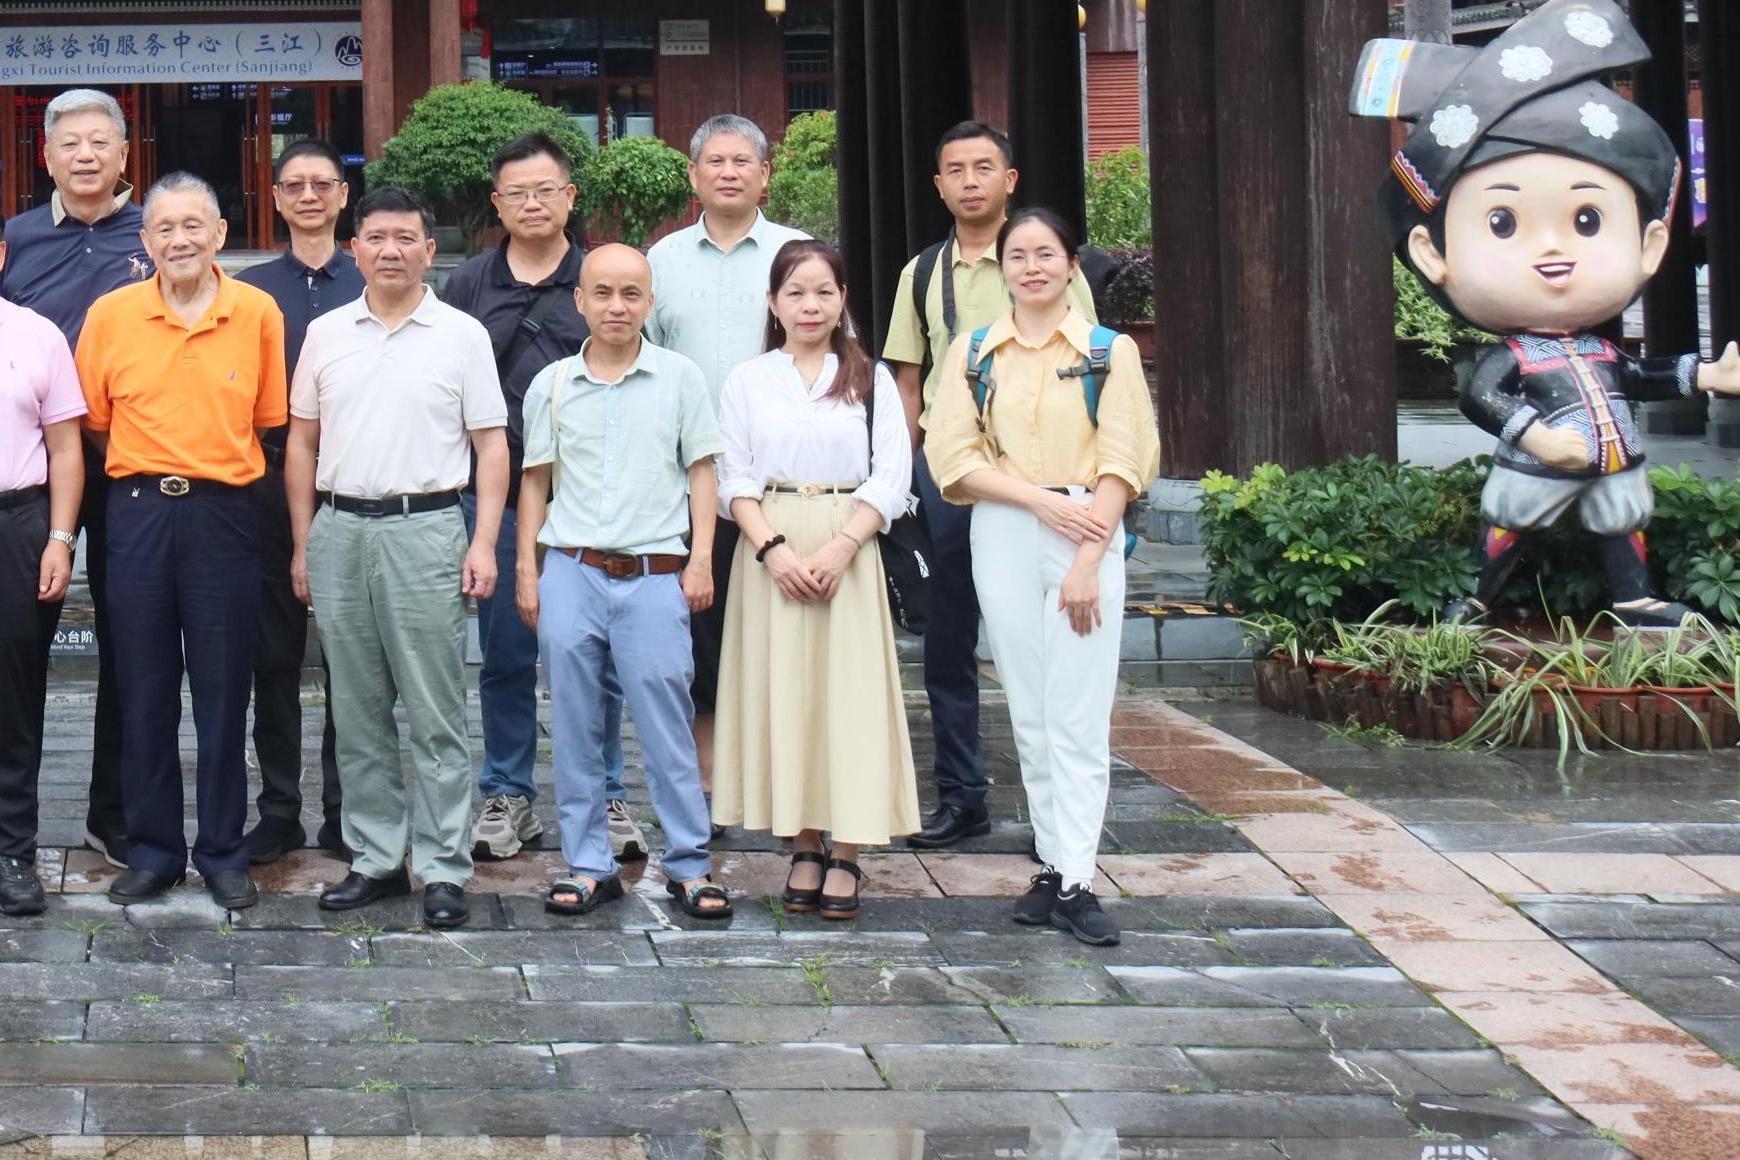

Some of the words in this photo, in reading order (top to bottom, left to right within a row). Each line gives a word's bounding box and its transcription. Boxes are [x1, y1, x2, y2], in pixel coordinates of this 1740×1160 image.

[29, 62, 82, 76] Tourist
[86, 60, 176, 76] Information
[180, 60, 231, 75] Center
[235, 59, 313, 77] (Sanjiang)
